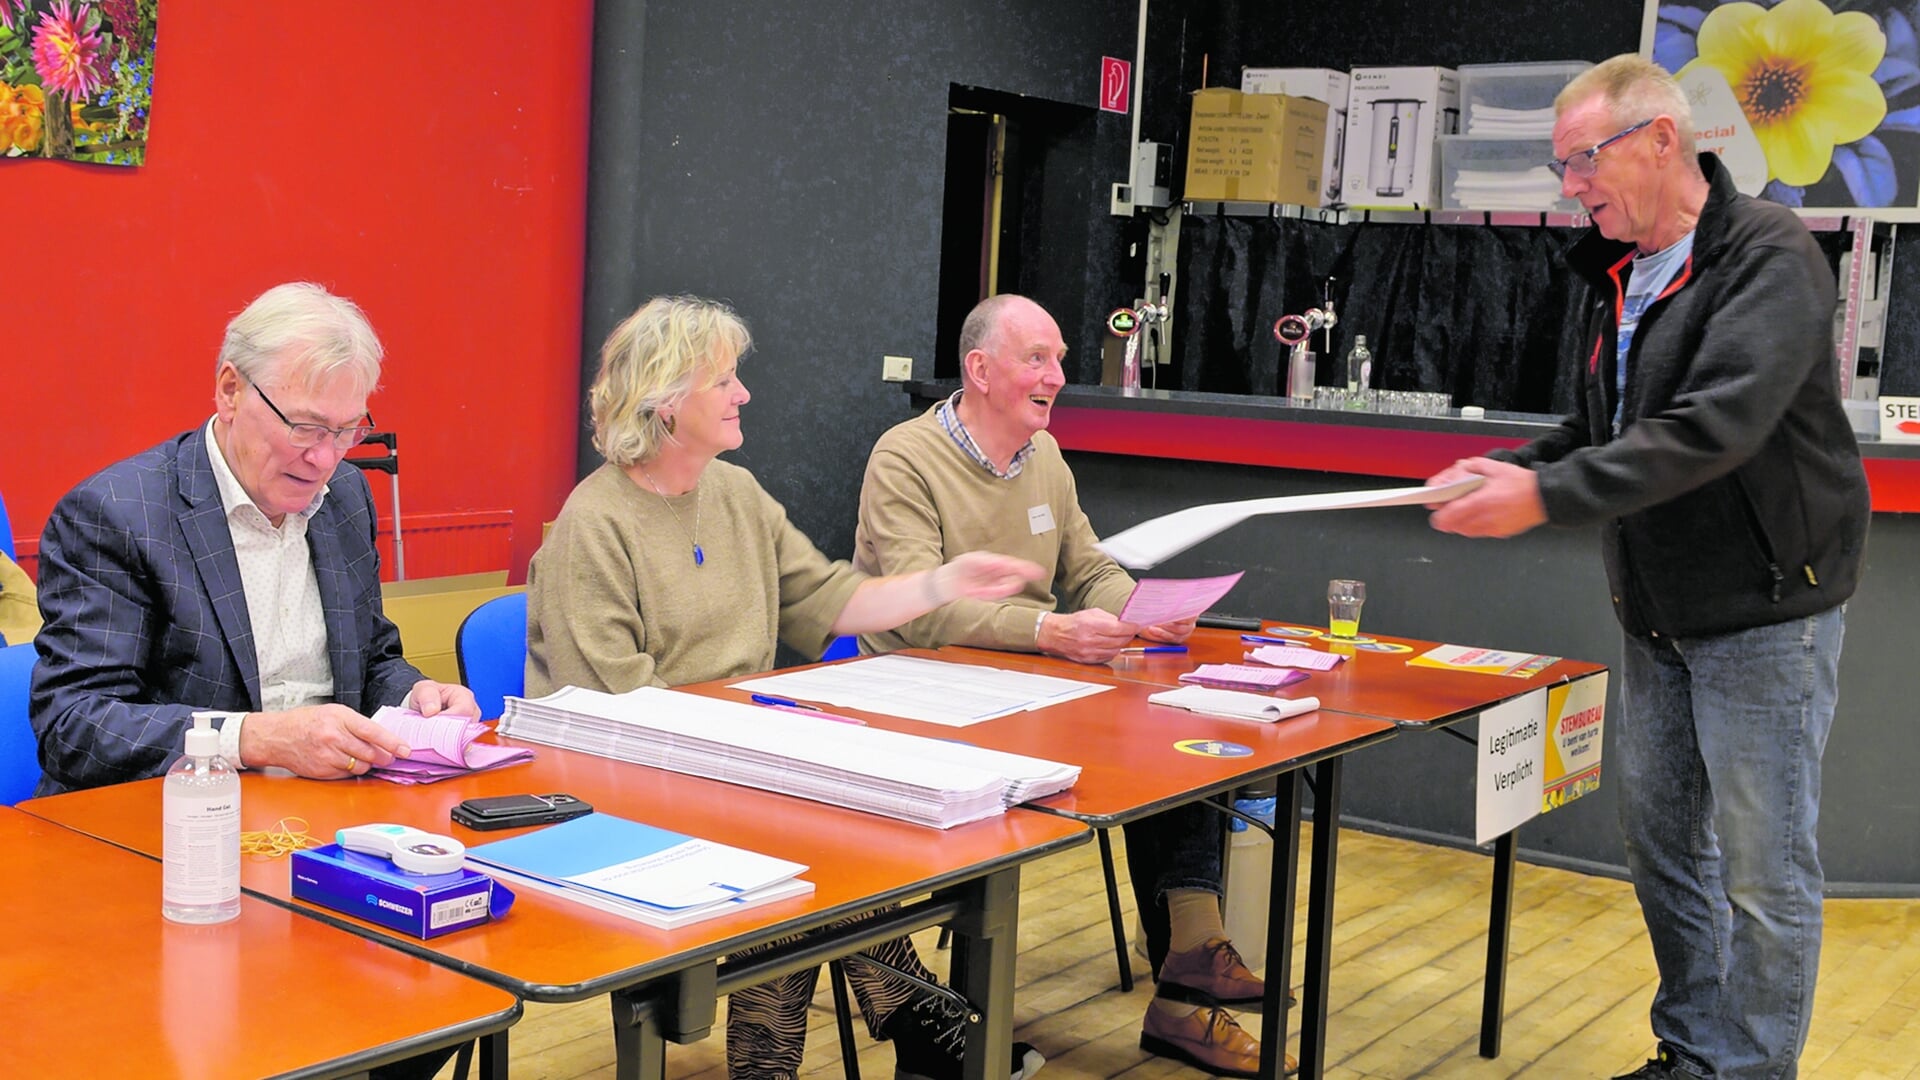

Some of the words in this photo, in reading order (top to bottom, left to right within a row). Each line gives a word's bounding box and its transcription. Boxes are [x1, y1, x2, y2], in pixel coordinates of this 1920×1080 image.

[1695, 124, 1735, 140] ecial
[1886, 404, 1920, 418] STE
[1560, 703, 1603, 735] STEMBUREAU
[1490, 718, 1538, 755] Legitimatie
[1494, 758, 1533, 791] Verplicht
[378, 898, 414, 917] SCHWEIZER
